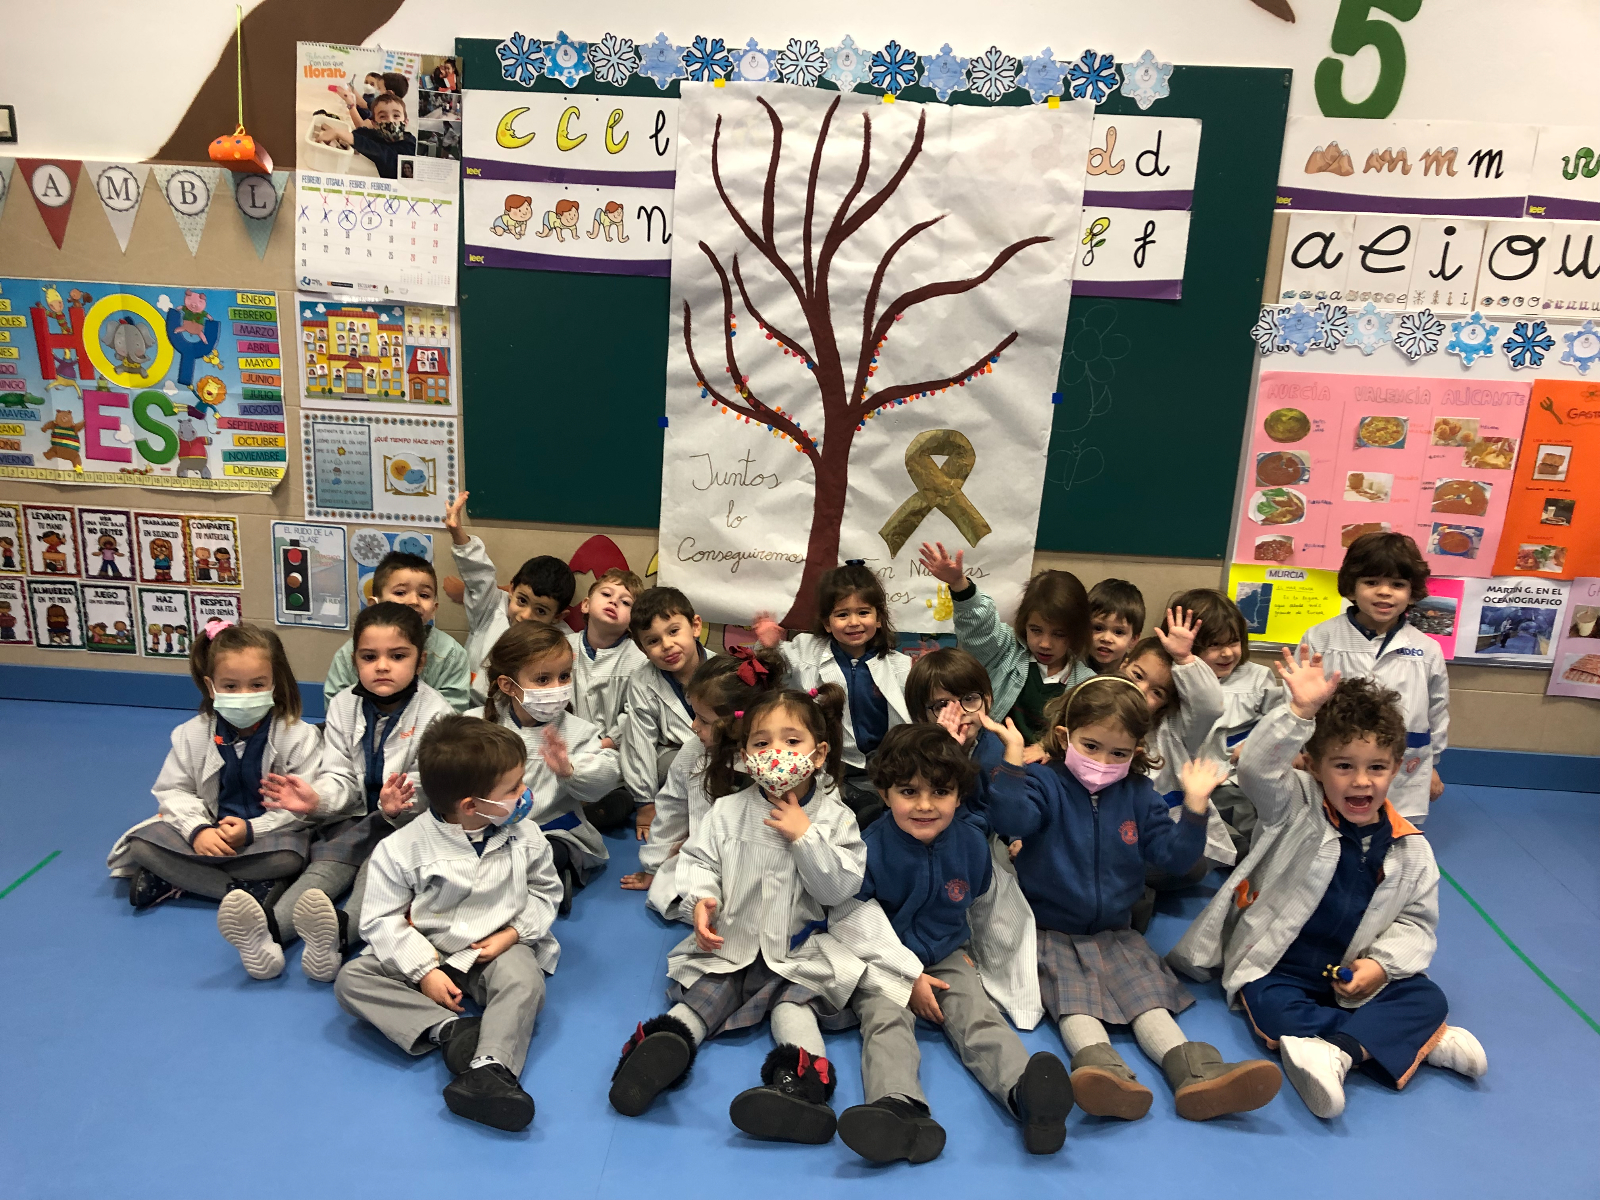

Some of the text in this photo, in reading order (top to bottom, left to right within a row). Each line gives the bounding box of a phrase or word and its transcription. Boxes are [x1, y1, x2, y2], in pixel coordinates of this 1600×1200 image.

[303, 65, 346, 78] lloran
[1136, 130, 1170, 176] d
[1468, 149, 1504, 179] m
[41, 173, 267, 209] A M B L
[1134, 220, 1156, 268] f
[1359, 224, 1412, 274] e
[1291, 231, 1344, 270] a
[1429, 225, 1464, 281] i
[1488, 234, 1547, 281] o
[241, 294, 272, 306] ENERO
[233, 309, 273, 321] FEBRERO
[239, 325, 275, 338] MARZO
[30, 293, 221, 388] HOY
[246, 342, 272, 353] ABRIL
[244, 358, 274, 368] MAYO
[246, 373, 275, 386] JUNIO
[249, 390, 274, 400] JULIO
[243, 404, 281, 414] AGOSTO
[83, 389, 181, 465] ES
[227, 420, 279, 432] SEPTIEMBRE
[238, 436, 279, 447] OCTUBRE
[228, 450, 280, 461] NOVIEMBRE
[233, 466, 280, 479] DICIEMBRE
[689, 449, 782, 491] Juntos
[31, 511, 67, 521] LEVANTA
[726, 500, 748, 529] lo
[142, 519, 180, 527] TRABAJAMOS
[191, 522, 231, 532] COMPARTE
[294, 527, 312, 535] RUIDO
[314, 528, 322, 536] DE
[299, 535, 319, 544] CLASE
[677, 537, 806, 573] Conseguiremos
[1269, 570, 1304, 579] MURCIA
[33, 587, 73, 595] ALMUERZO
[93, 591, 119, 599] JUEGO
[1536, 587, 1550, 595] EN
[1552, 588, 1563, 596] EL
[156, 595, 173, 604] HAZ
[200, 598, 233, 607] RESPETA
[1483, 596, 1562, 606] OCEANOGRAFICO
